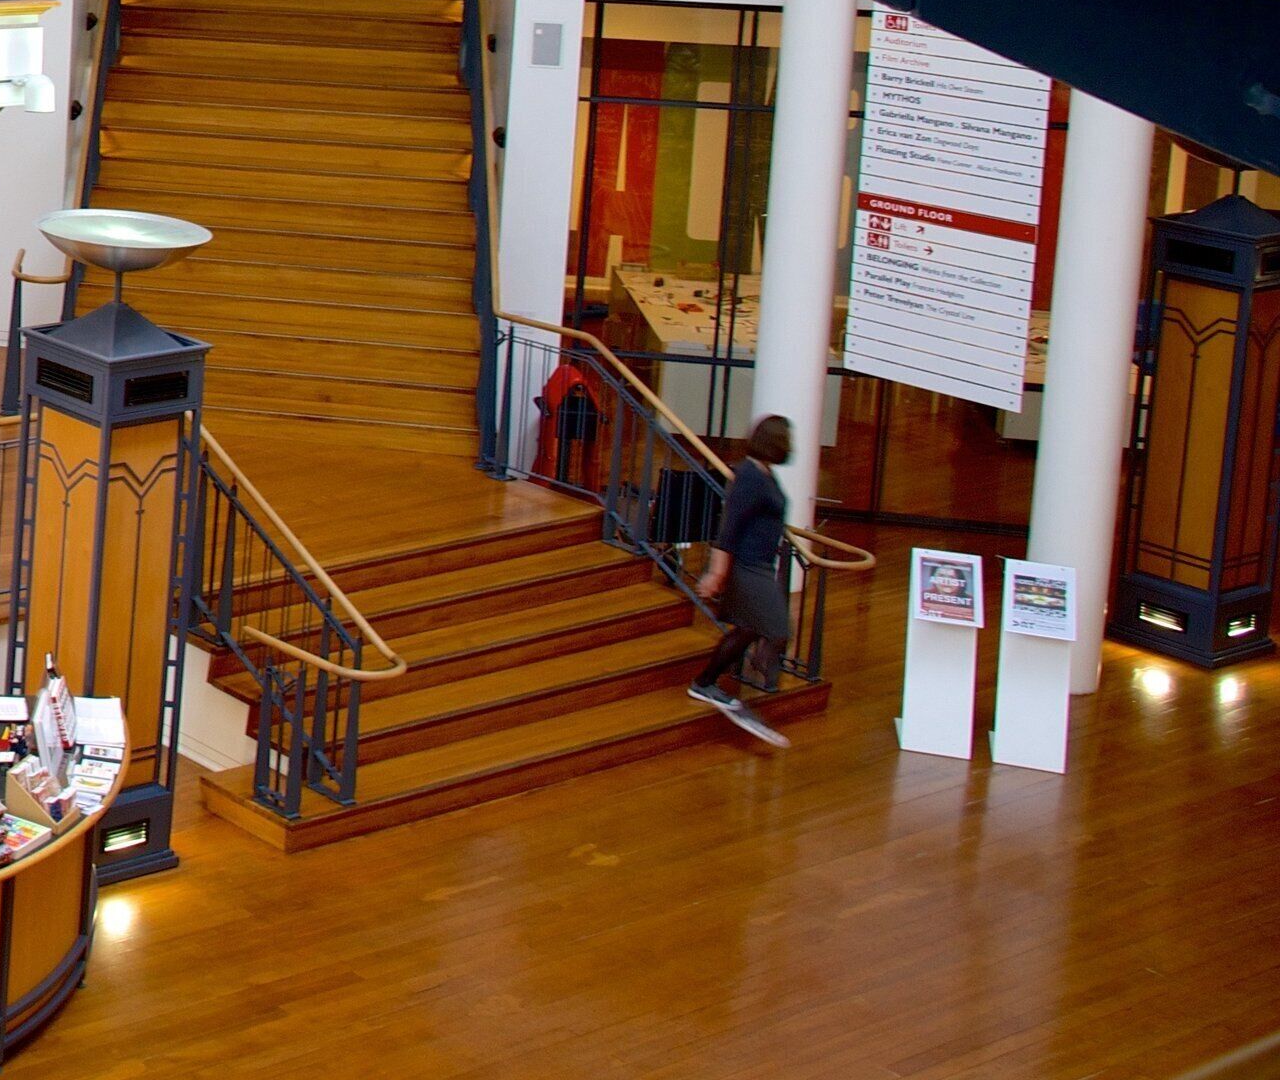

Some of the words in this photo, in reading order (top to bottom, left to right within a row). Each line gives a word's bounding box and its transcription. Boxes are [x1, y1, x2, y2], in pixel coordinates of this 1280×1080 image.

[883, 37, 927, 48] Auditorium
[882, 54, 899, 62] Film
[900, 56, 929, 68] Archive
[881, 73, 903, 85] Barry
[905, 76, 935, 87] Brickell
[882, 92, 921, 105] MYTHOS
[879, 109, 915, 121] Gabriella
[917, 115, 954, 128] Mangano
[961, 122, 991, 134] Silvana
[992, 127, 1032, 141] Mangano
[877, 127, 897, 138] Erica
[876, 145, 907, 159] Floating
[909, 150, 936, 162] Studio
[869, 199, 915, 215] GROUND
[918, 209, 953, 222] FLOOR
[894, 240, 918, 252] Toilets
[866, 253, 919, 270] BELONGING
[942, 269, 957, 280] from
[958, 273, 969, 281] the
[864, 270, 893, 283] Parallel
[894, 277, 911, 288] Play
[863, 289, 884, 300] Peter
[886, 293, 924, 310] Trevelyan
[923, 592, 972, 605] PRESENT
